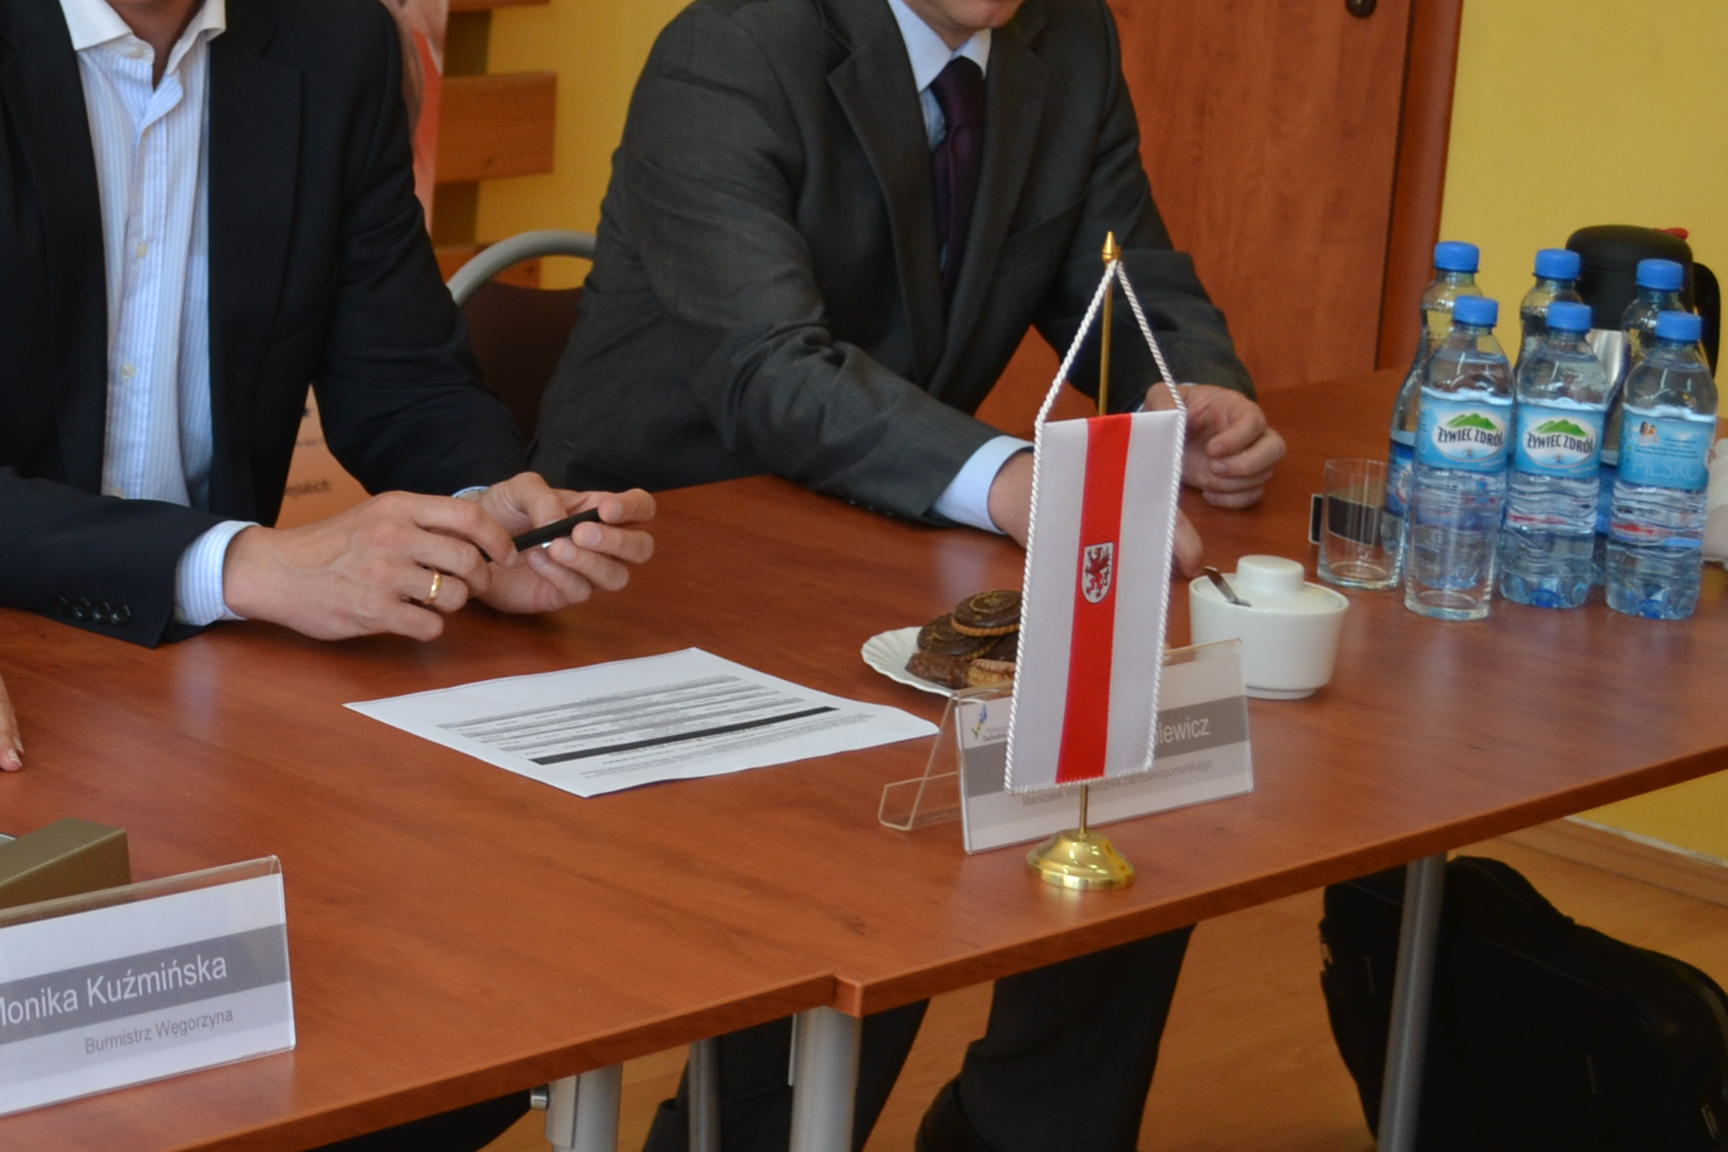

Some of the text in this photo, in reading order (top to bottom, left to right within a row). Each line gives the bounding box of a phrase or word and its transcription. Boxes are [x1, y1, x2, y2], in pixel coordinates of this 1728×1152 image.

[86, 954, 228, 1008] Kuźmińska
[84, 1006, 234, 1054] Burmistrz Węgorzyna
